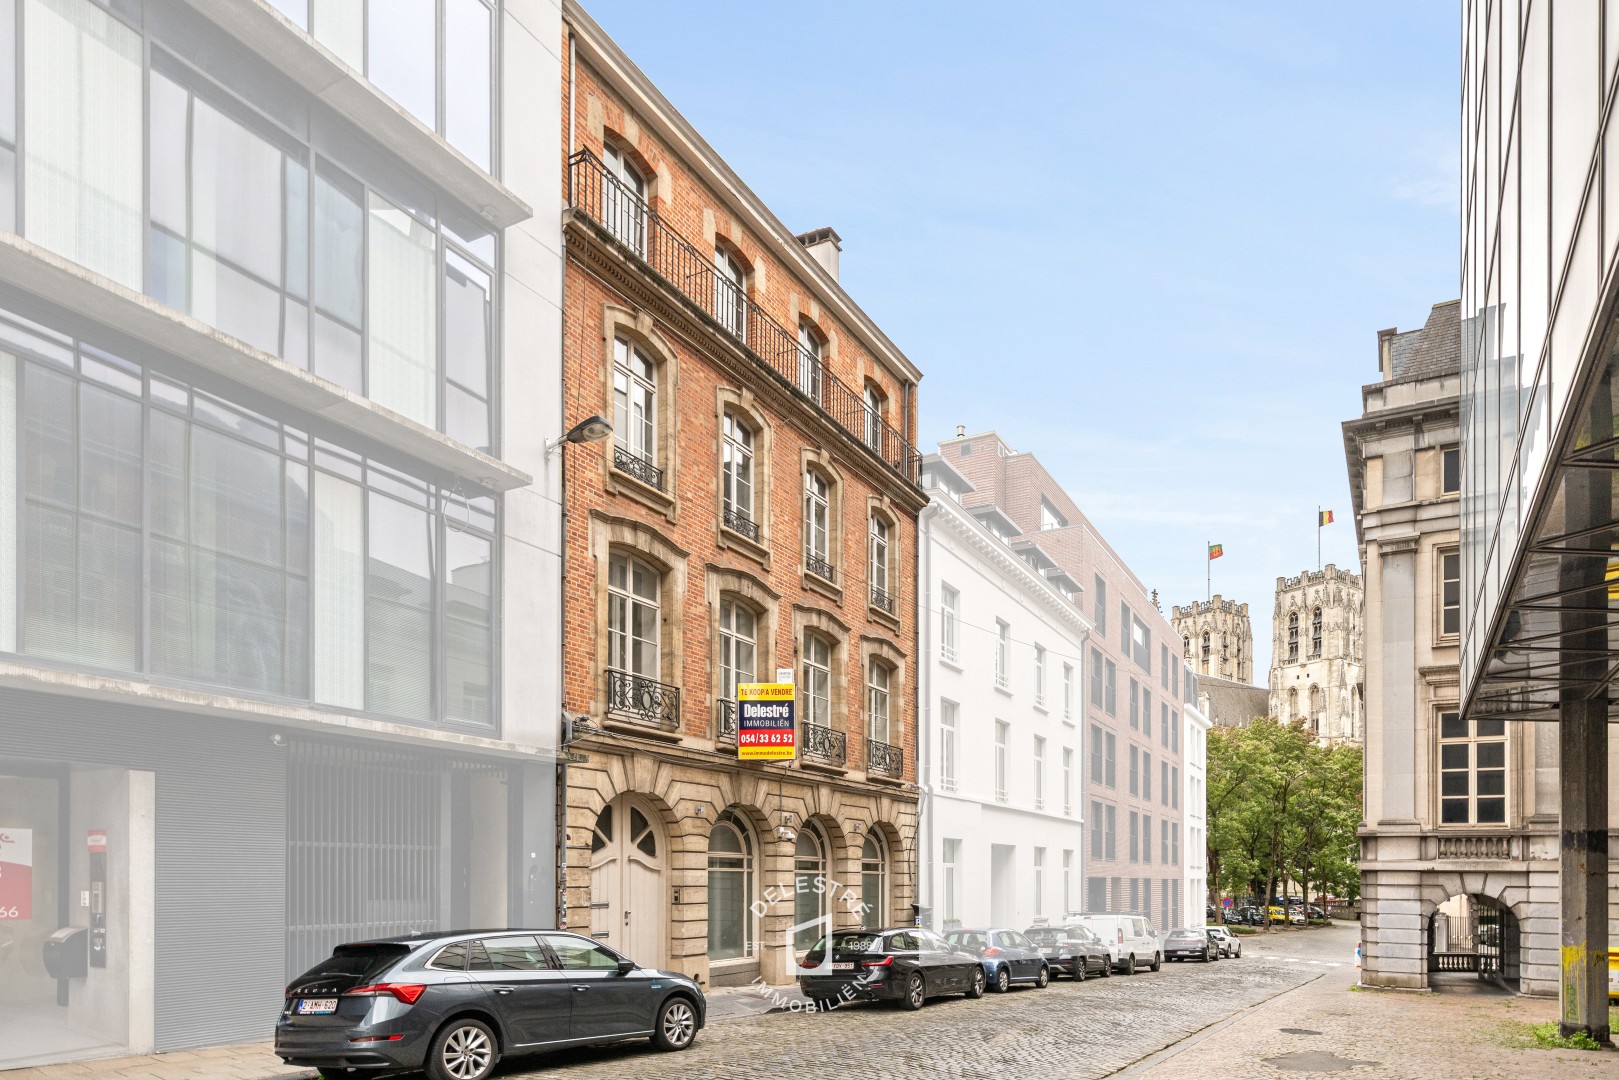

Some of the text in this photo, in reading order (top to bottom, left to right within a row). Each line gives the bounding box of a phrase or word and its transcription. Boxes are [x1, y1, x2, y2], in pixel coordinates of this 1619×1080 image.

[744, 703, 789, 718] Delestré
[744, 719, 789, 727] IMMOBILIËN
[741, 733, 792, 744] 054/33 62 52
